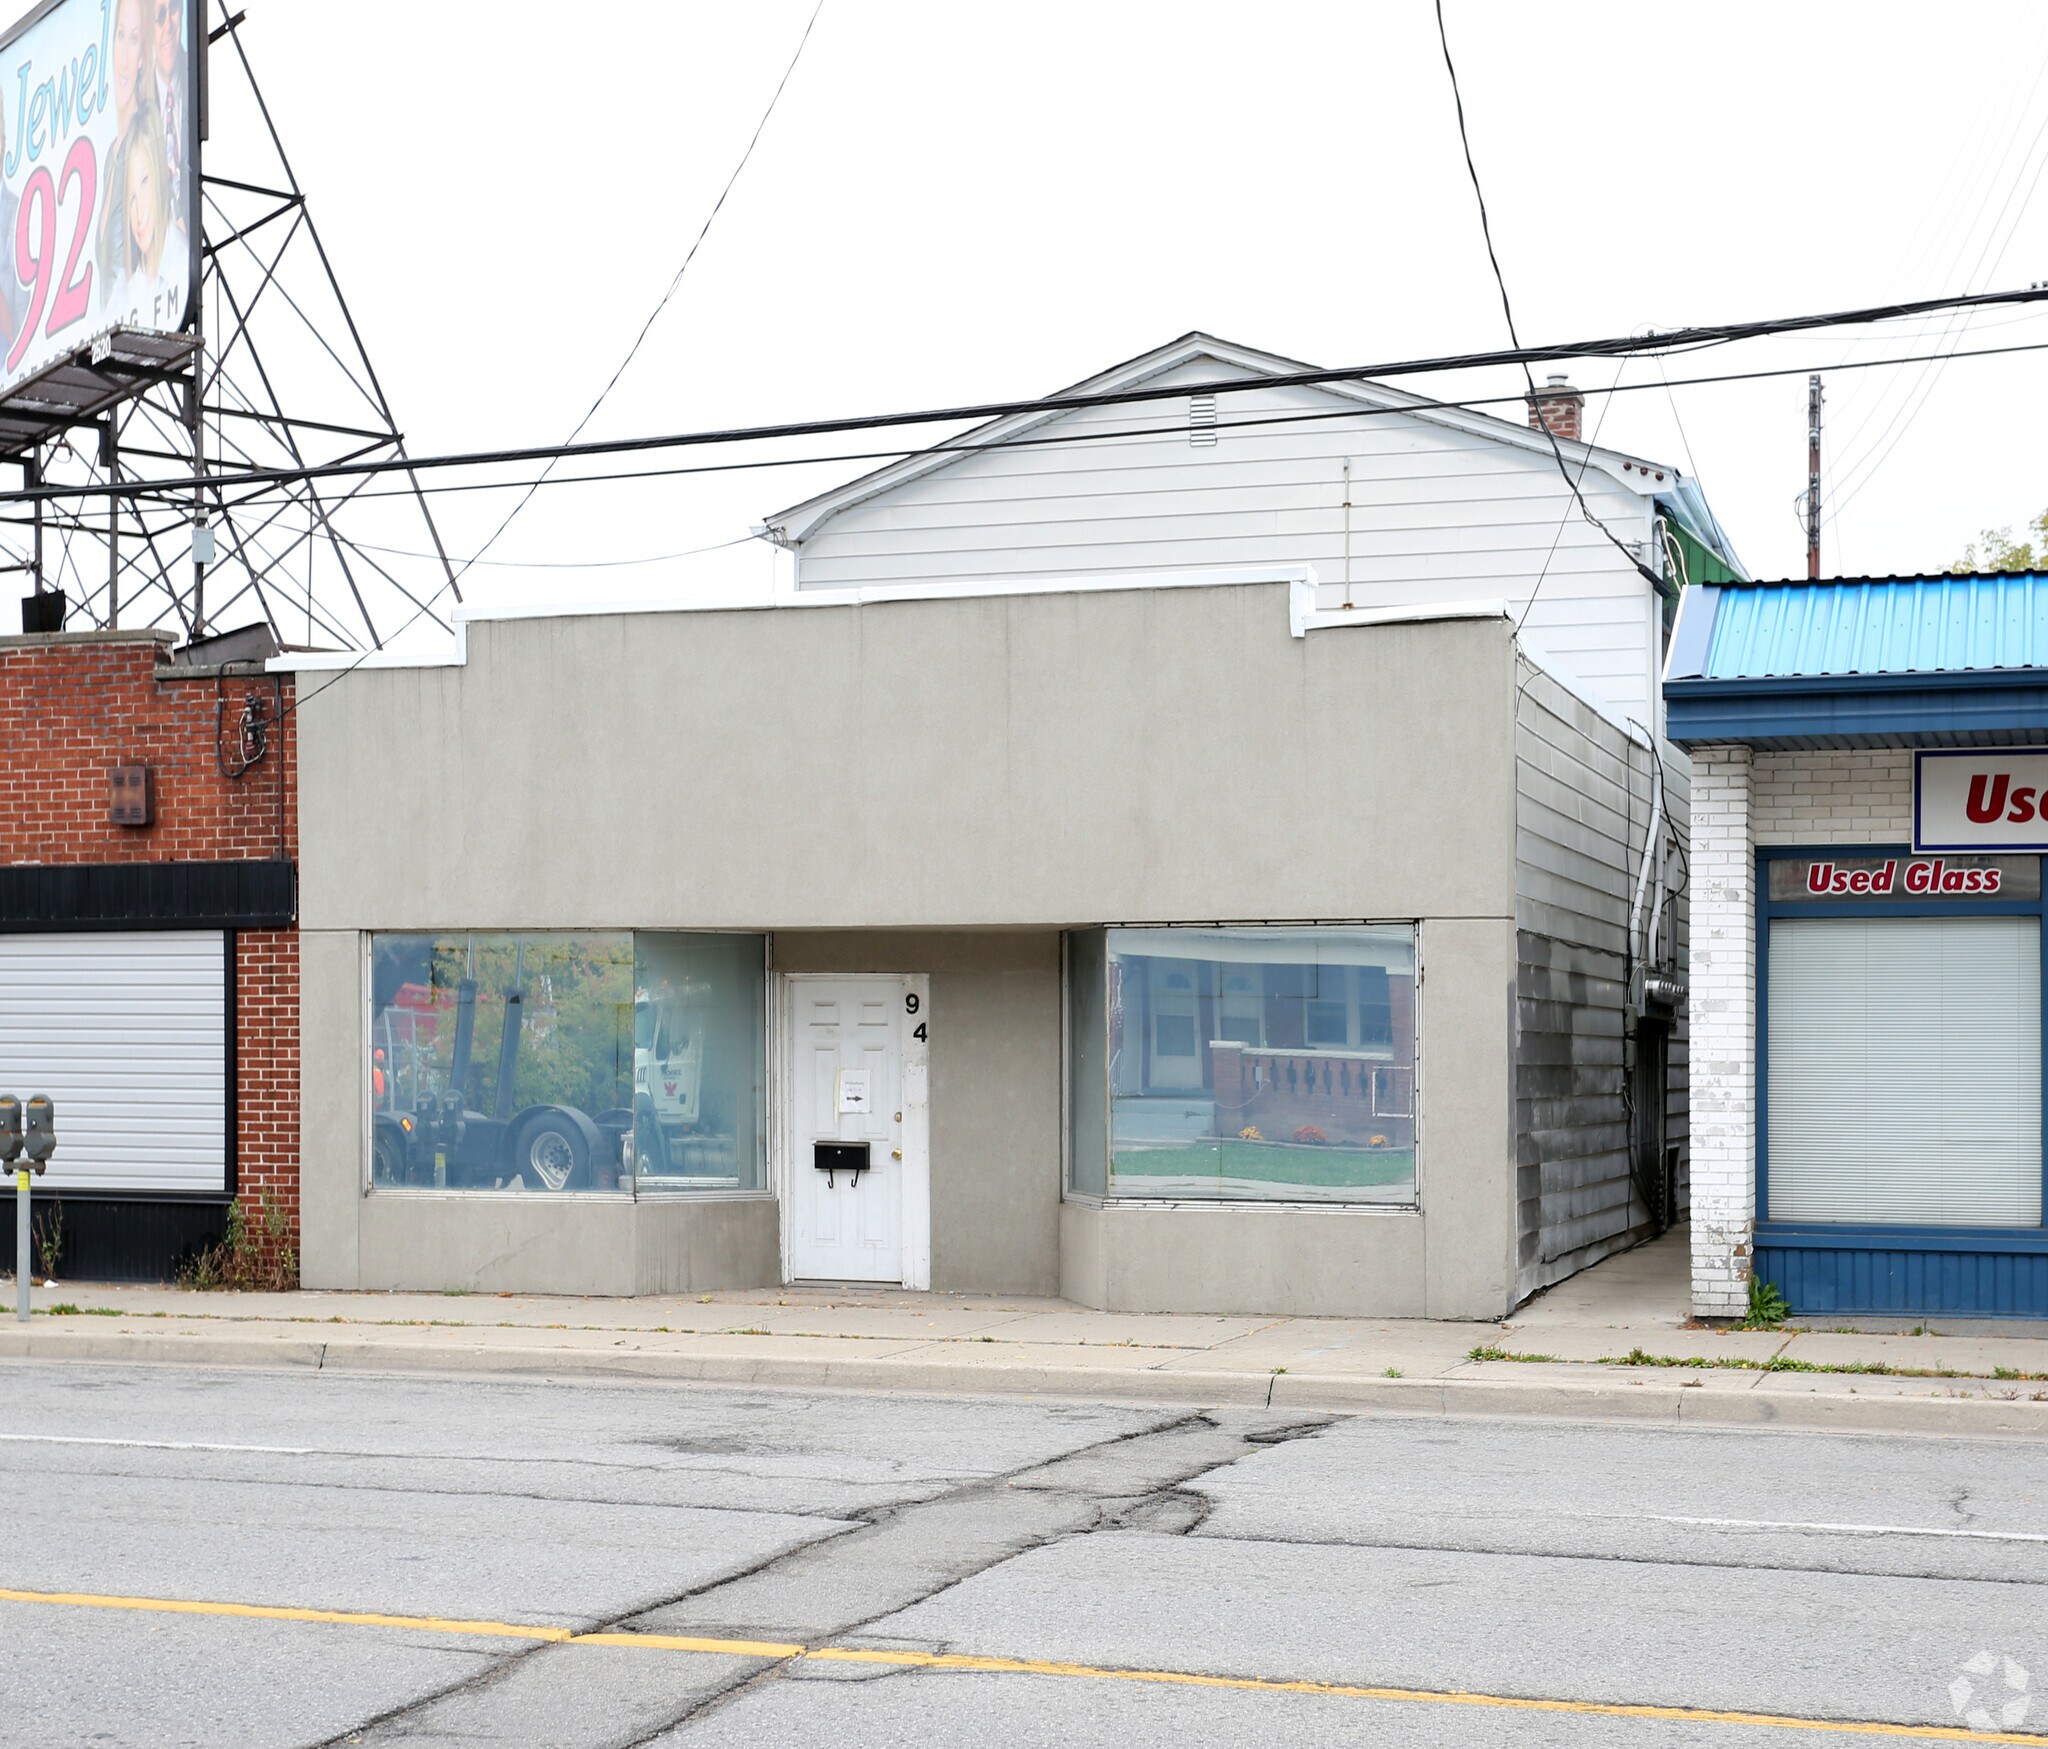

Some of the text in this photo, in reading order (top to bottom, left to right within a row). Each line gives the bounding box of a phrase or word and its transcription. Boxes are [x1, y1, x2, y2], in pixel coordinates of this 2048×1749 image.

[5, 0, 111, 179] Jewel
[7, 136, 97, 370] 92
[154, 284, 178, 328] FM
[91, 334, 111, 366] 2520
[1808, 859, 2001, 895] Used Glass
[905, 993, 920, 1015] 9
[913, 1022, 928, 1043] 4
